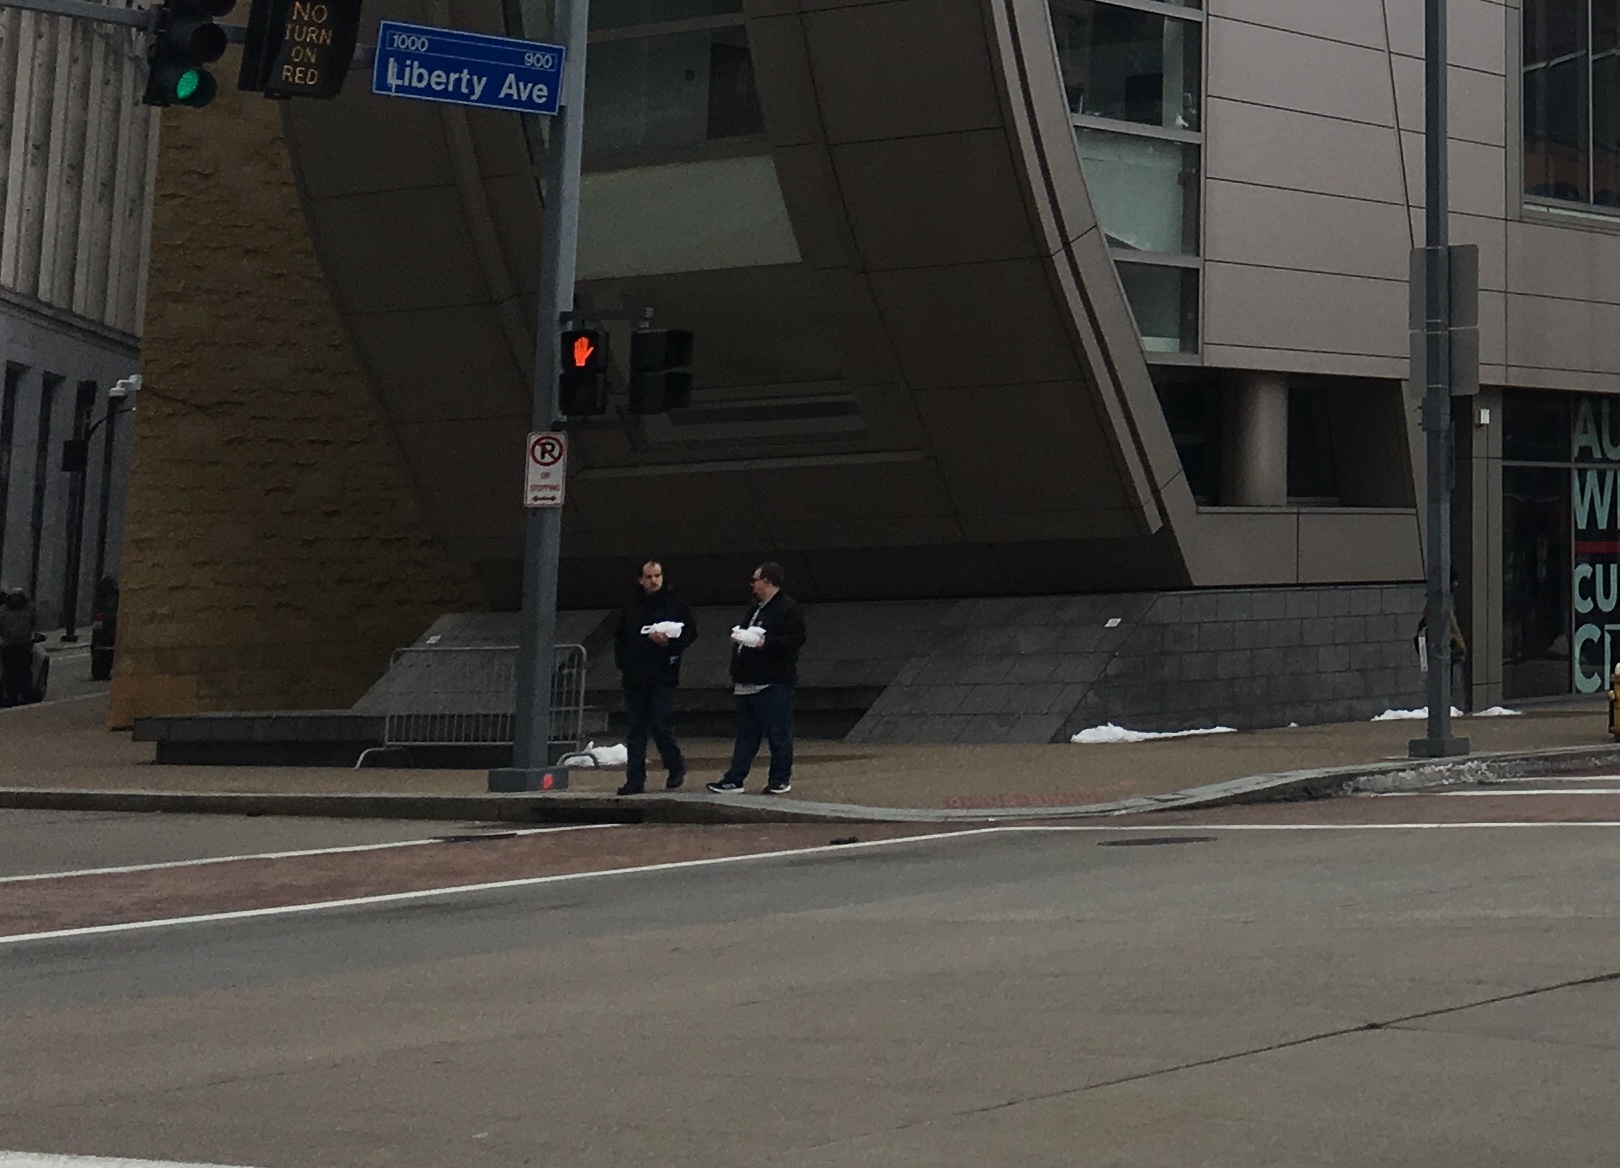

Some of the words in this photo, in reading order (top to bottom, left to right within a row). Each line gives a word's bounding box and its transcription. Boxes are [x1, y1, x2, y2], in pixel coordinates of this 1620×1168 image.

[292, 1, 328, 24] NO
[284, 23, 333, 46] TURN
[393, 34, 429, 52] 1000
[291, 45, 318, 64] ON
[525, 53, 553, 69] 900
[282, 65, 319, 85] RED
[387, 57, 488, 100] Liberty
[499, 73, 549, 104] Ave
